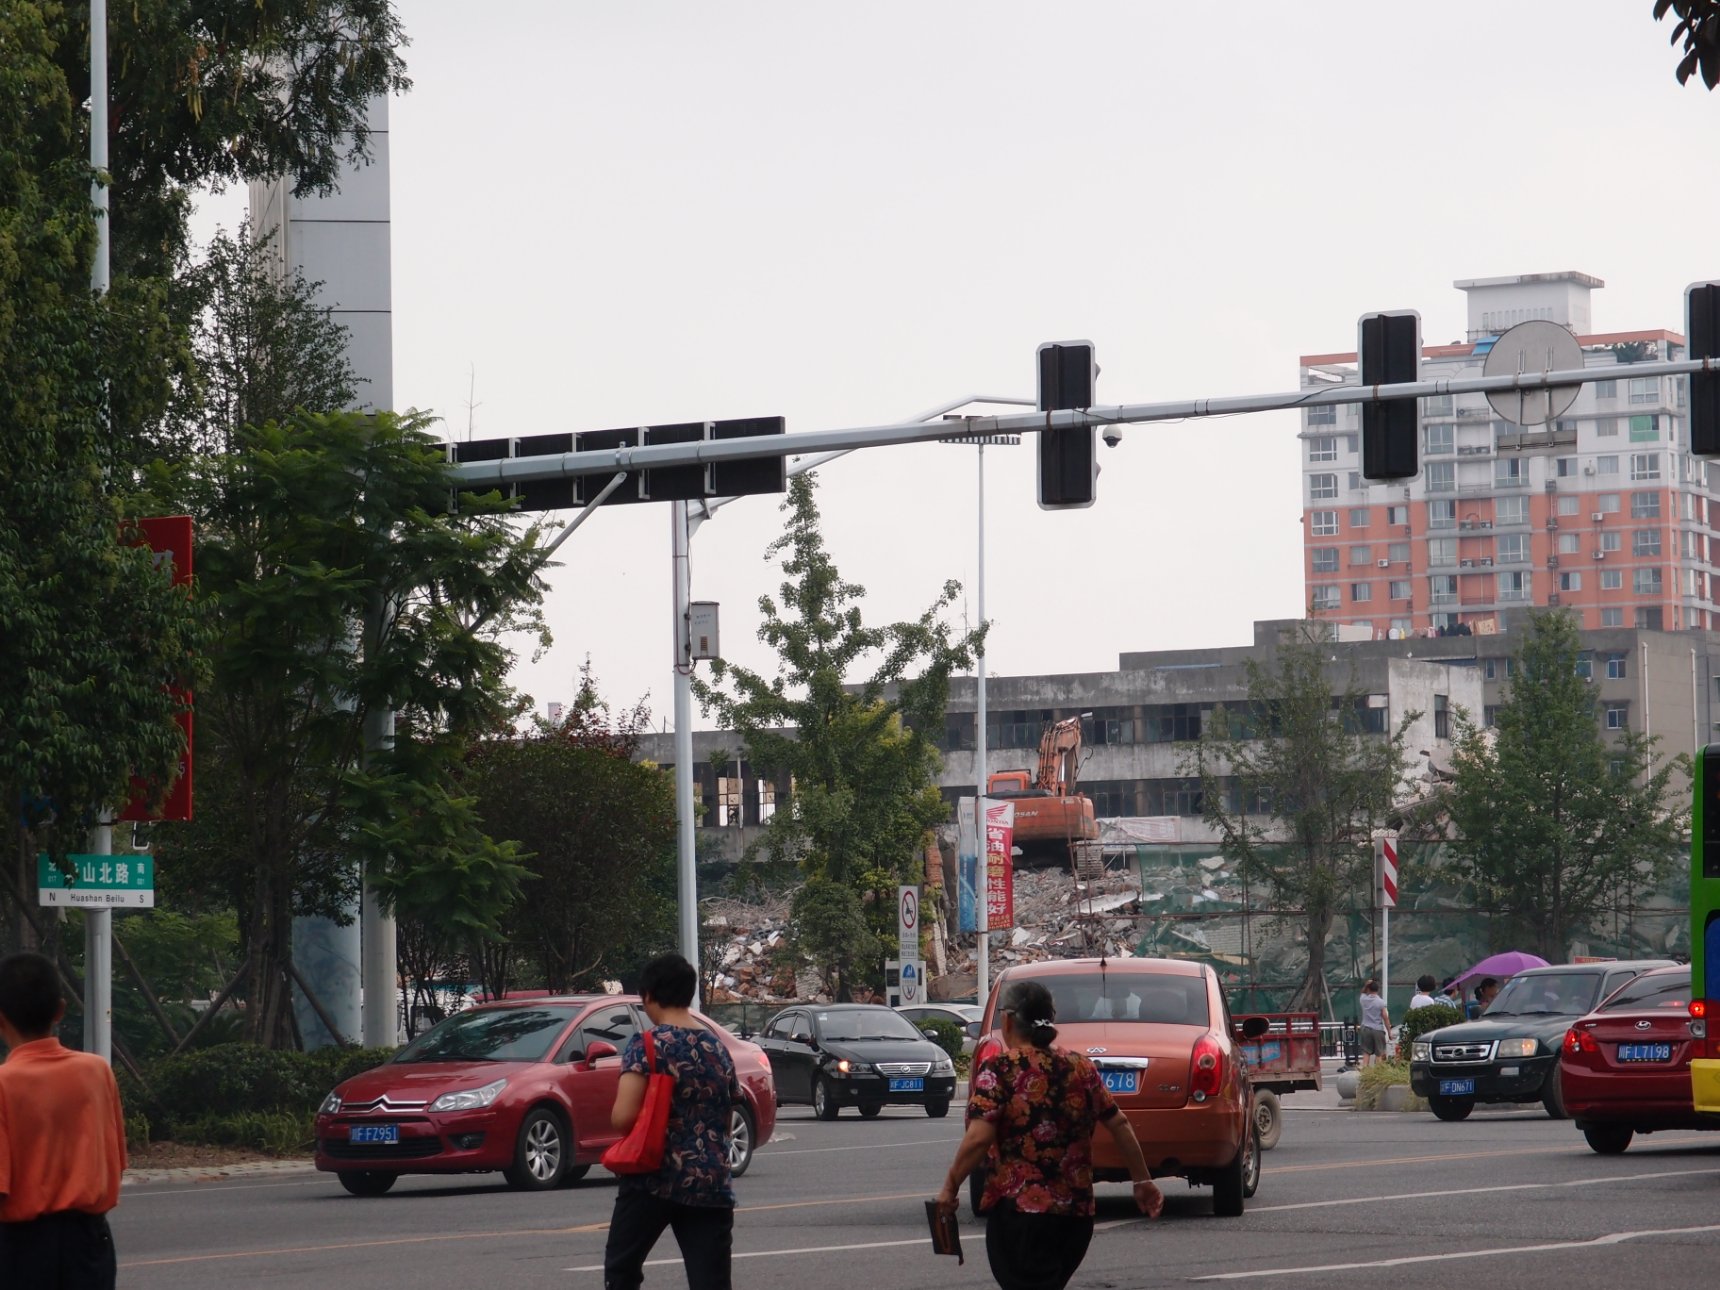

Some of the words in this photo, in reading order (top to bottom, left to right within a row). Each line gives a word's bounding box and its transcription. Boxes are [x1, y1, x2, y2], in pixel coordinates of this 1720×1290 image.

[74, 862, 129, 884] 山北路
[49, 892, 56, 902] N
[70, 893, 103, 903] Huashan
[105, 894, 125, 903] Beilu
[139, 894, 145, 904] S
